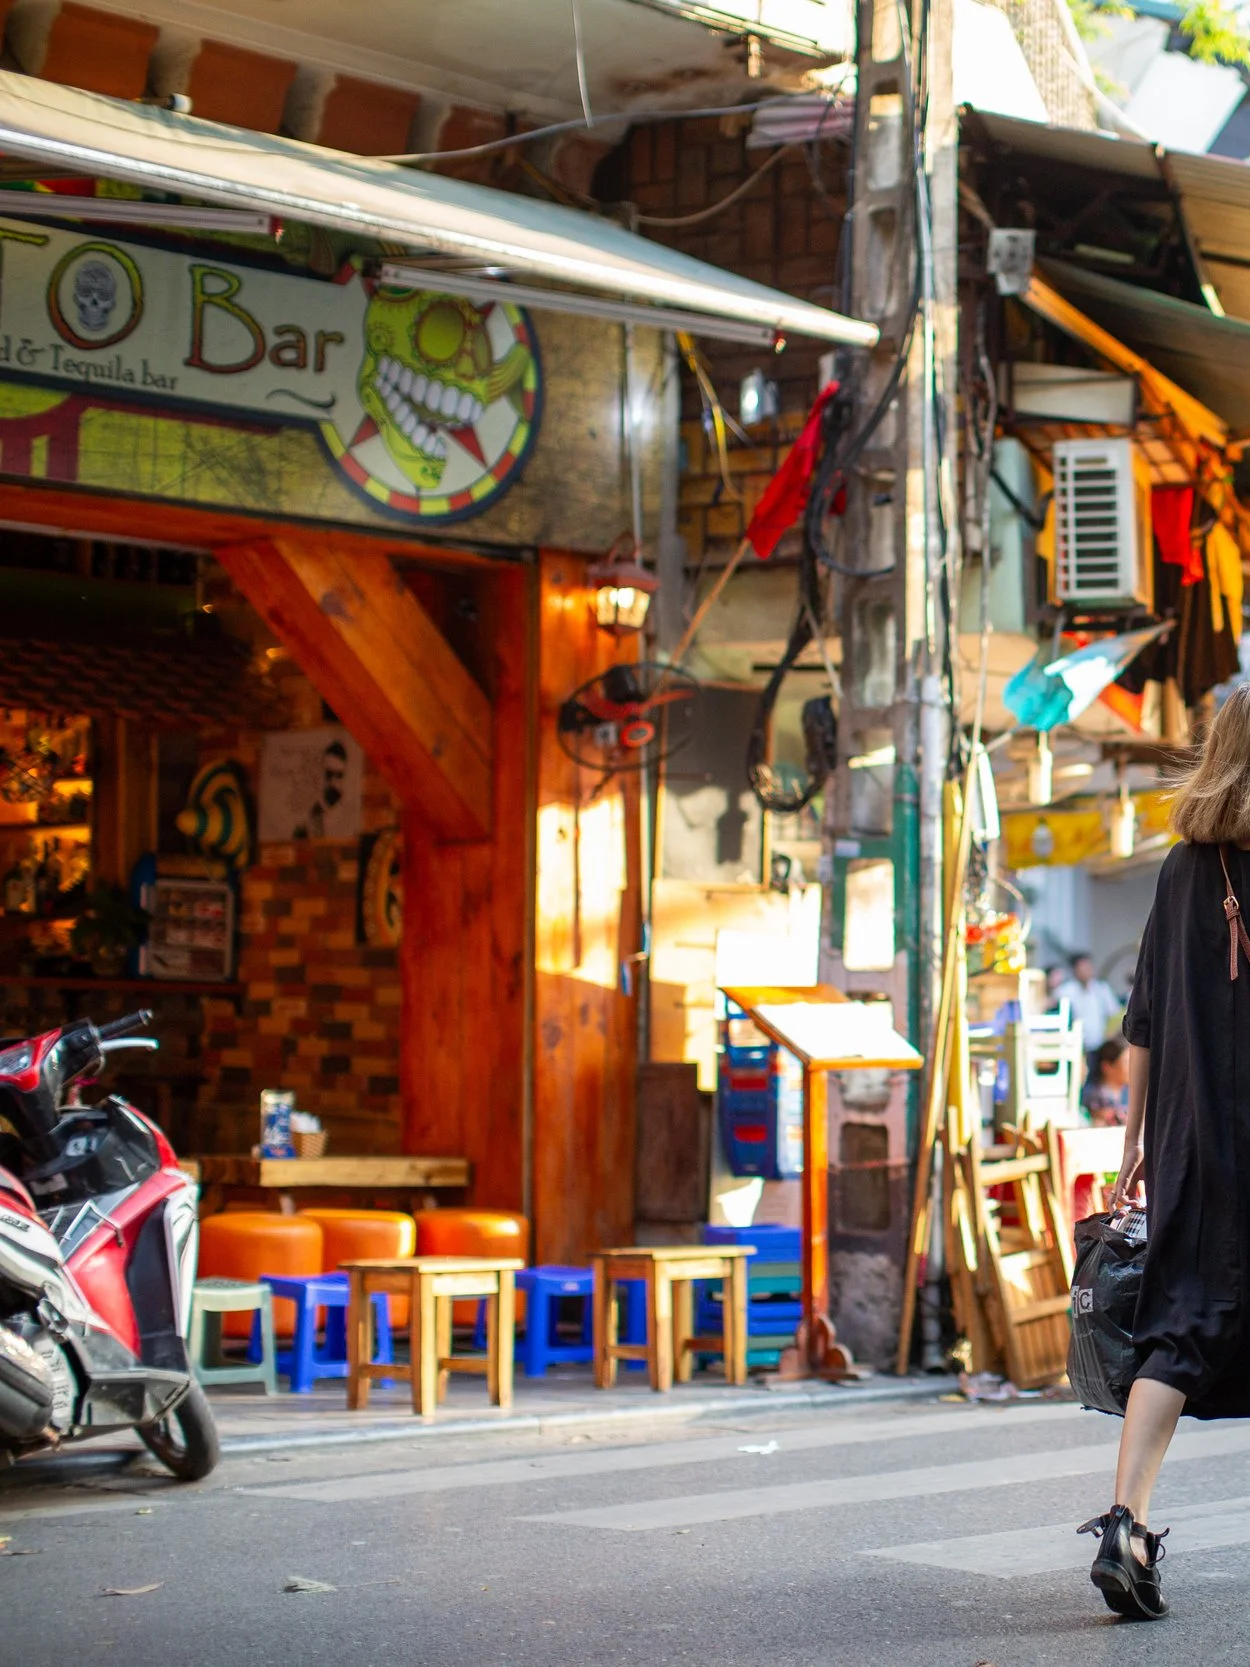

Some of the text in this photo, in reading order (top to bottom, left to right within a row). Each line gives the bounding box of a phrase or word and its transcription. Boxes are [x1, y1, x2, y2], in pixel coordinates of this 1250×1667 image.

[184, 262, 345, 374] Bar
[49, 343, 136, 383] Tequila
[141, 358, 179, 390] bar
